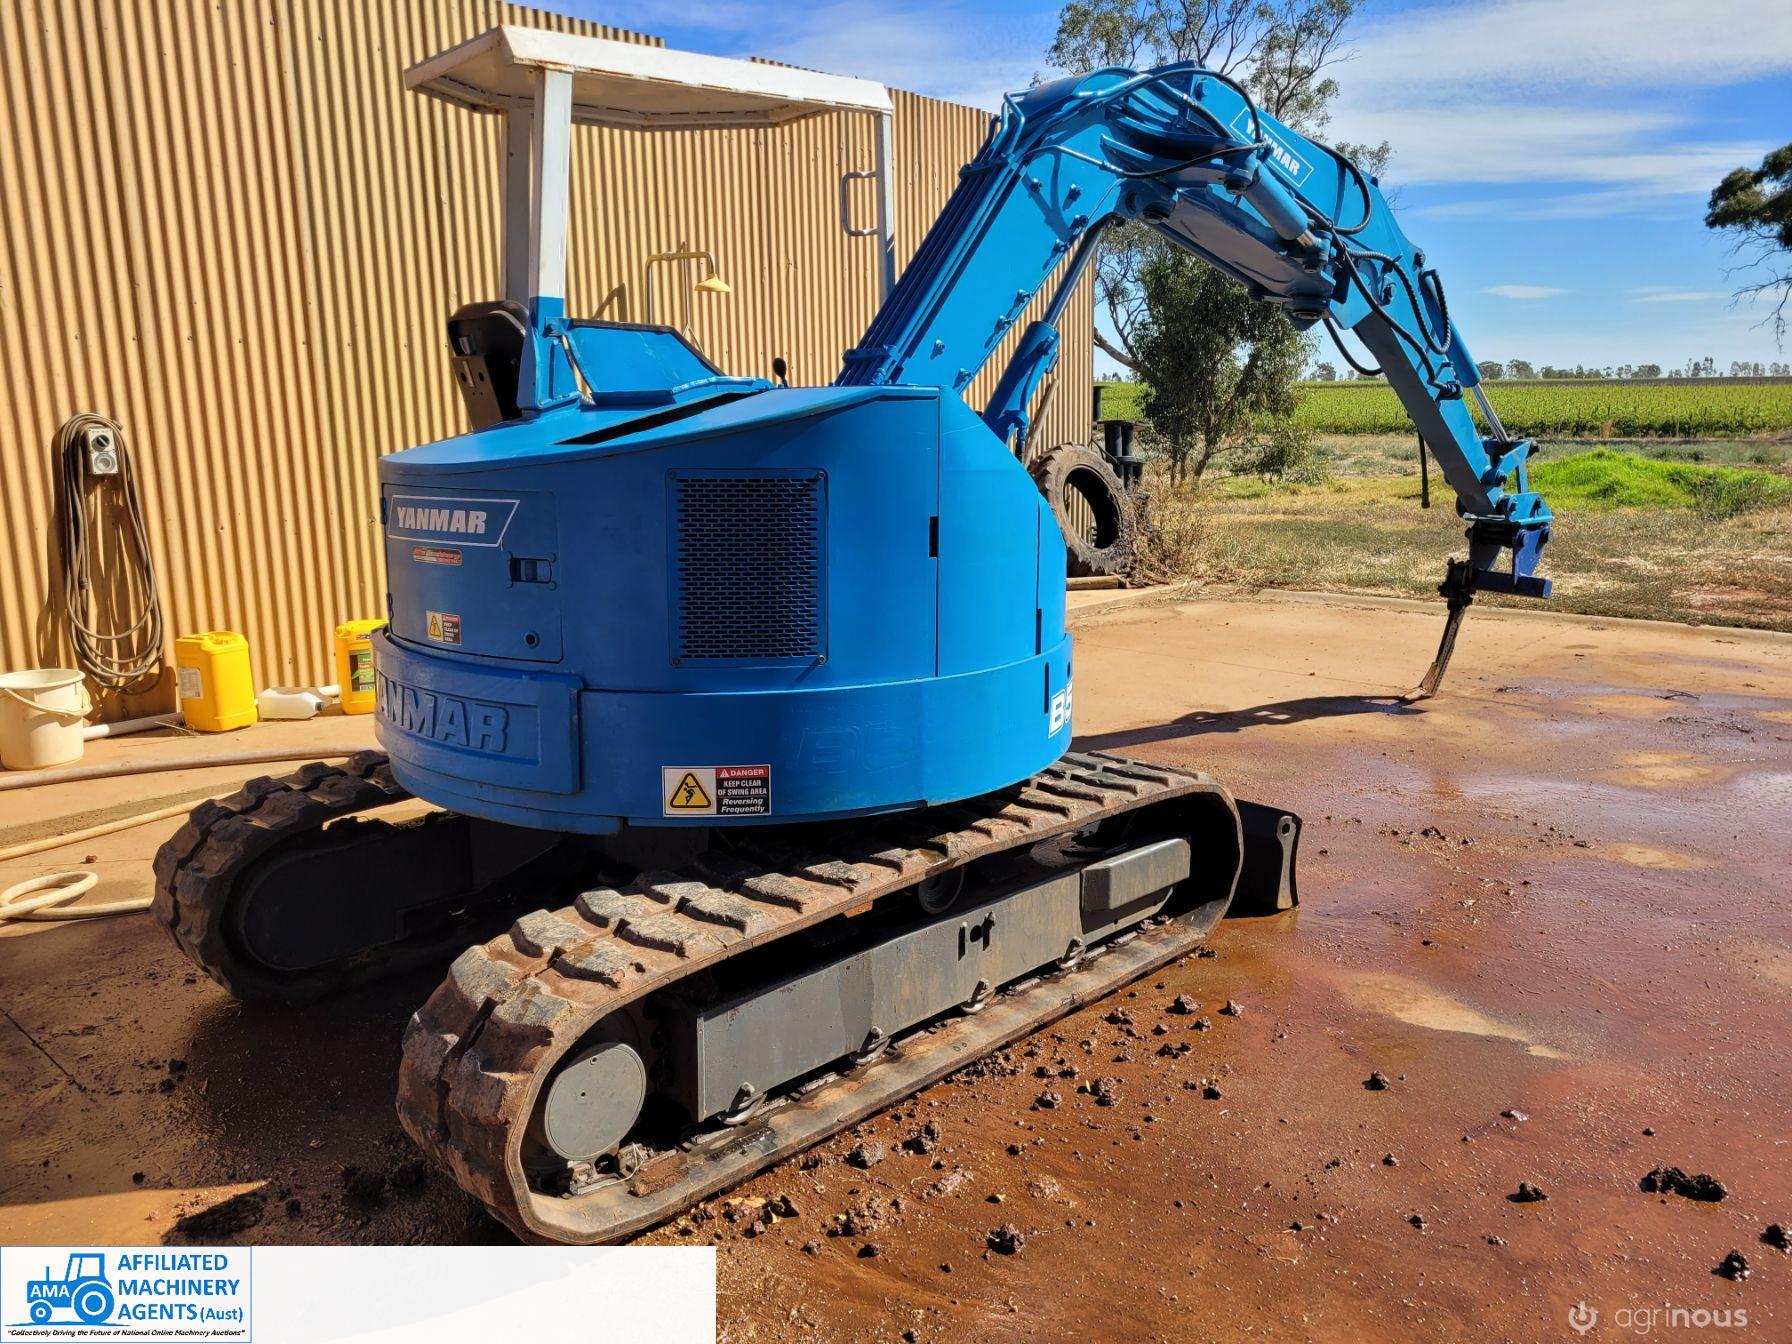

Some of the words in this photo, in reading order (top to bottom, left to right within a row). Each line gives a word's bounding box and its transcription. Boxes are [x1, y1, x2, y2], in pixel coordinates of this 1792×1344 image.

[1246, 118, 1300, 176] YMAR
[397, 506, 487, 534] YANMAR
[377, 669, 509, 753] ANMAR
[730, 769, 764, 777] DANGER
[727, 788, 749, 796] SWING
